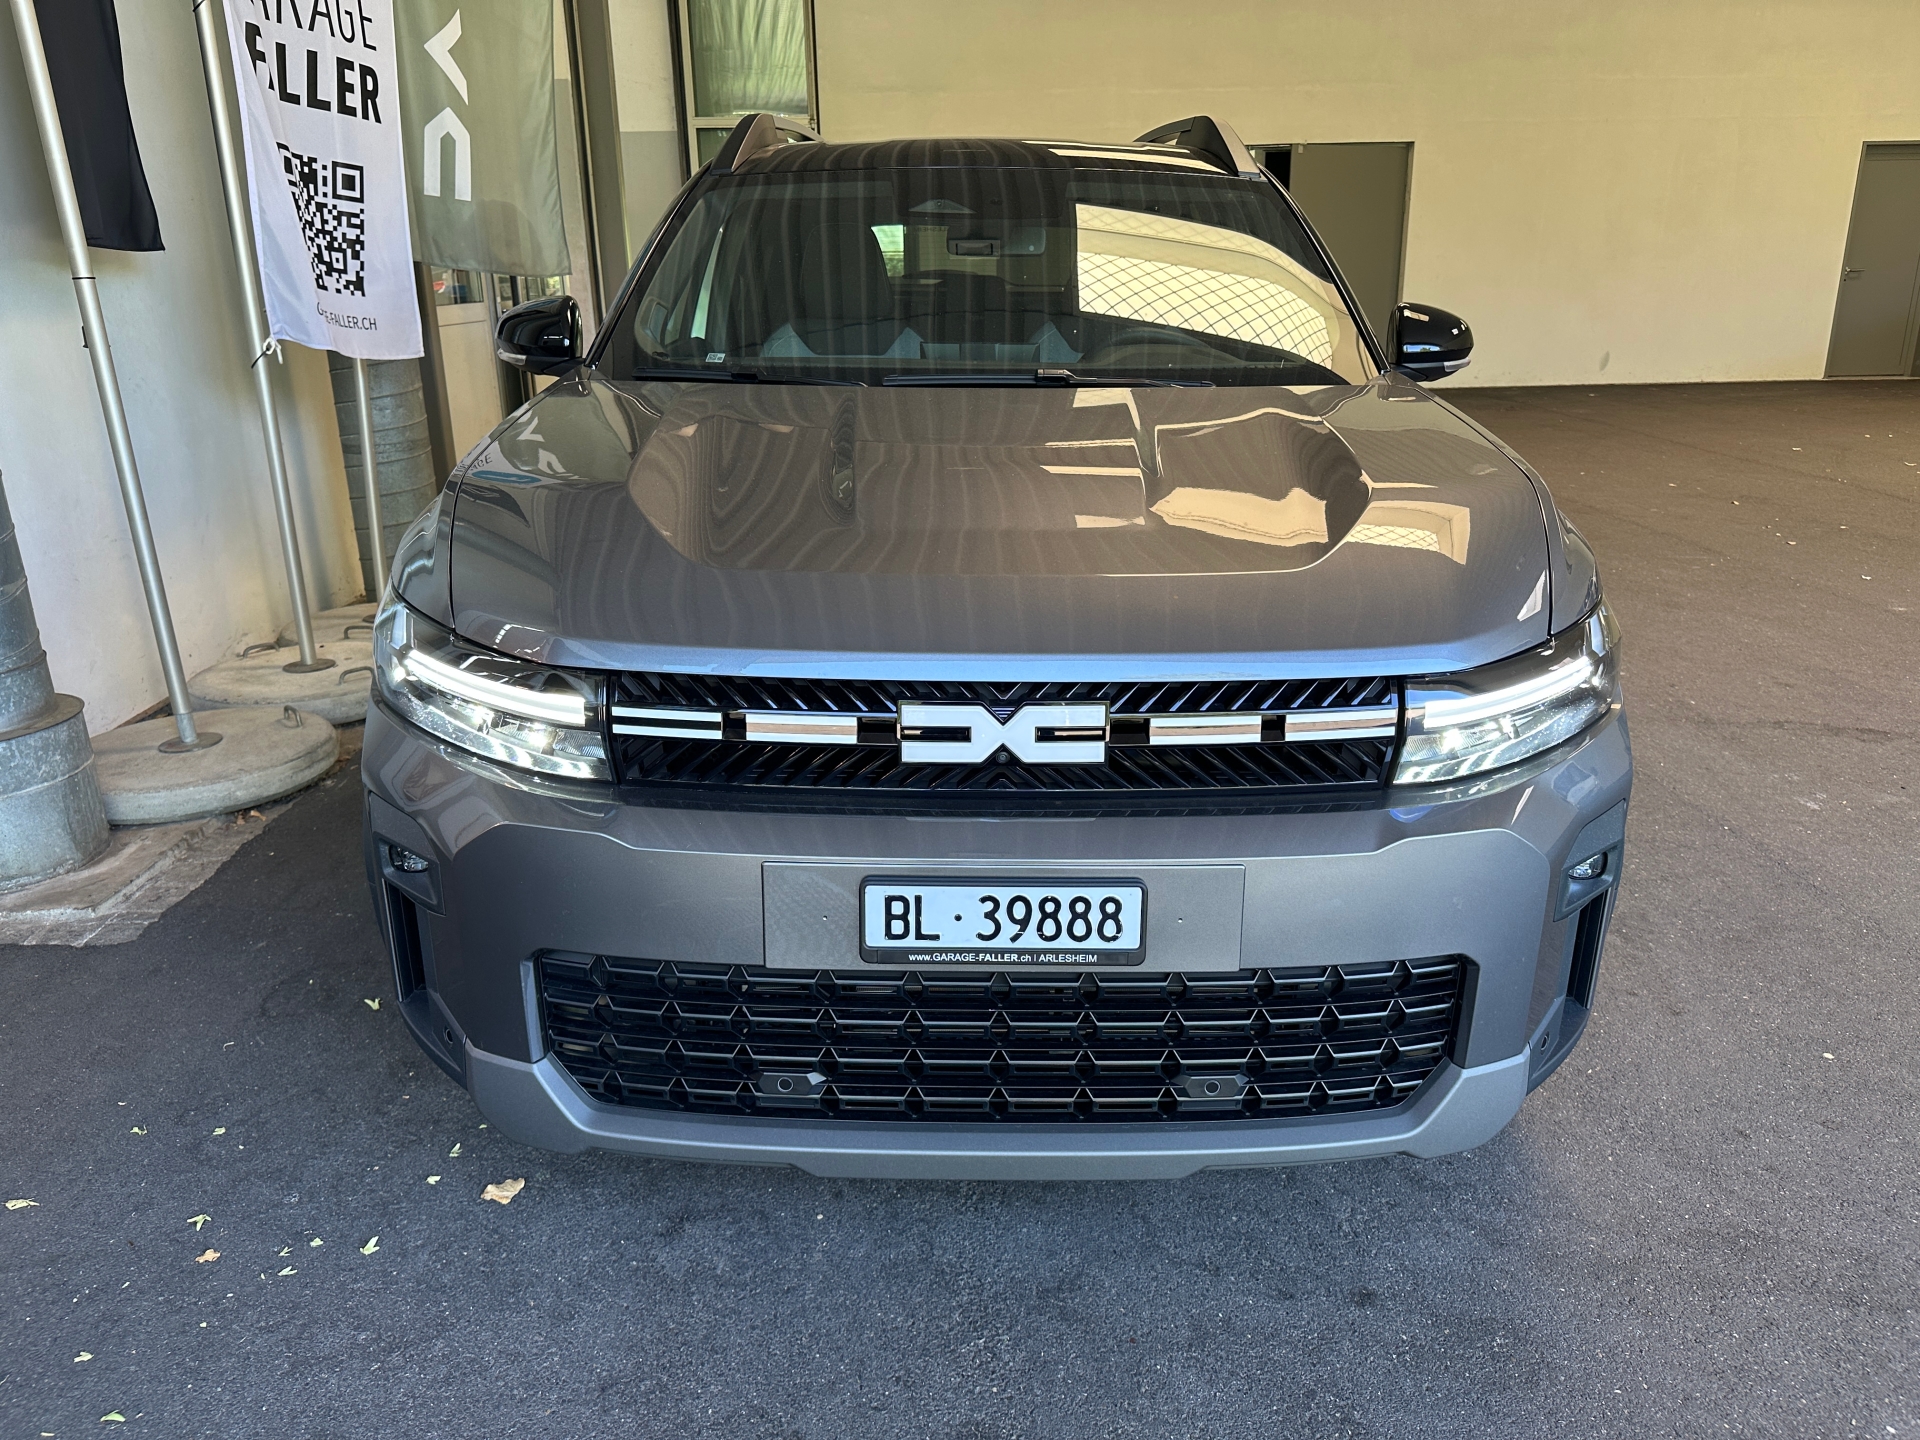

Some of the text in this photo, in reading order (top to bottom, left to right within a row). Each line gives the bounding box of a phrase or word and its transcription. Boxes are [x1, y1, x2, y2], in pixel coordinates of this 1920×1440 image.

[245, 21, 382, 125] FLLER
[884, 894, 941, 941] BL
[975, 894, 1124, 944] 39888
[908, 952, 1032, 962] www.GARAGE-FALLER.ch
[1038, 954, 1098, 963] ARLESHEIM
